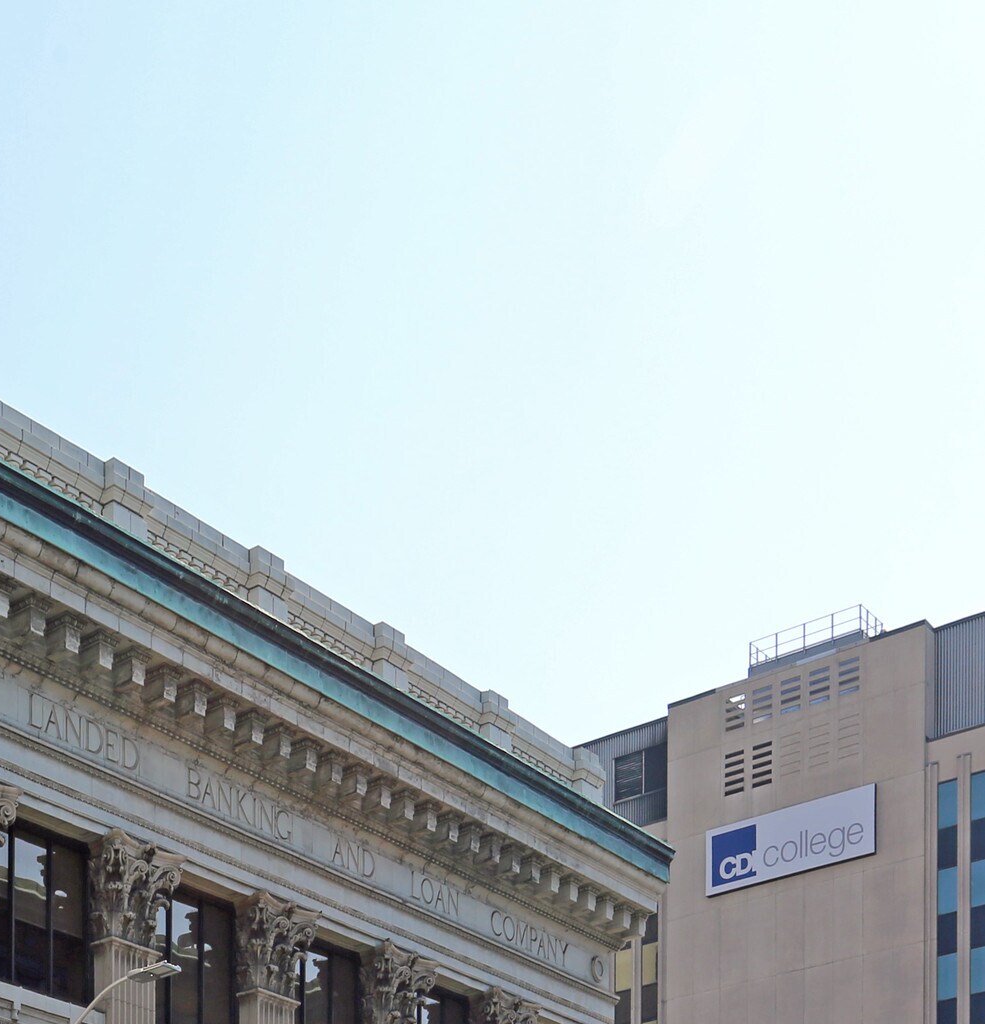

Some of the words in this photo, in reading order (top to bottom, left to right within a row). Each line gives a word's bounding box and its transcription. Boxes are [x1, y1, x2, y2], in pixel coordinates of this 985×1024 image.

[28, 693, 140, 771] LANDED
[187, 767, 292, 841] BANKING
[332, 838, 376, 878] AND
[409, 870, 460, 917] LOAN
[491, 910, 569, 967] COMPANY
[763, 822, 864, 867] college
